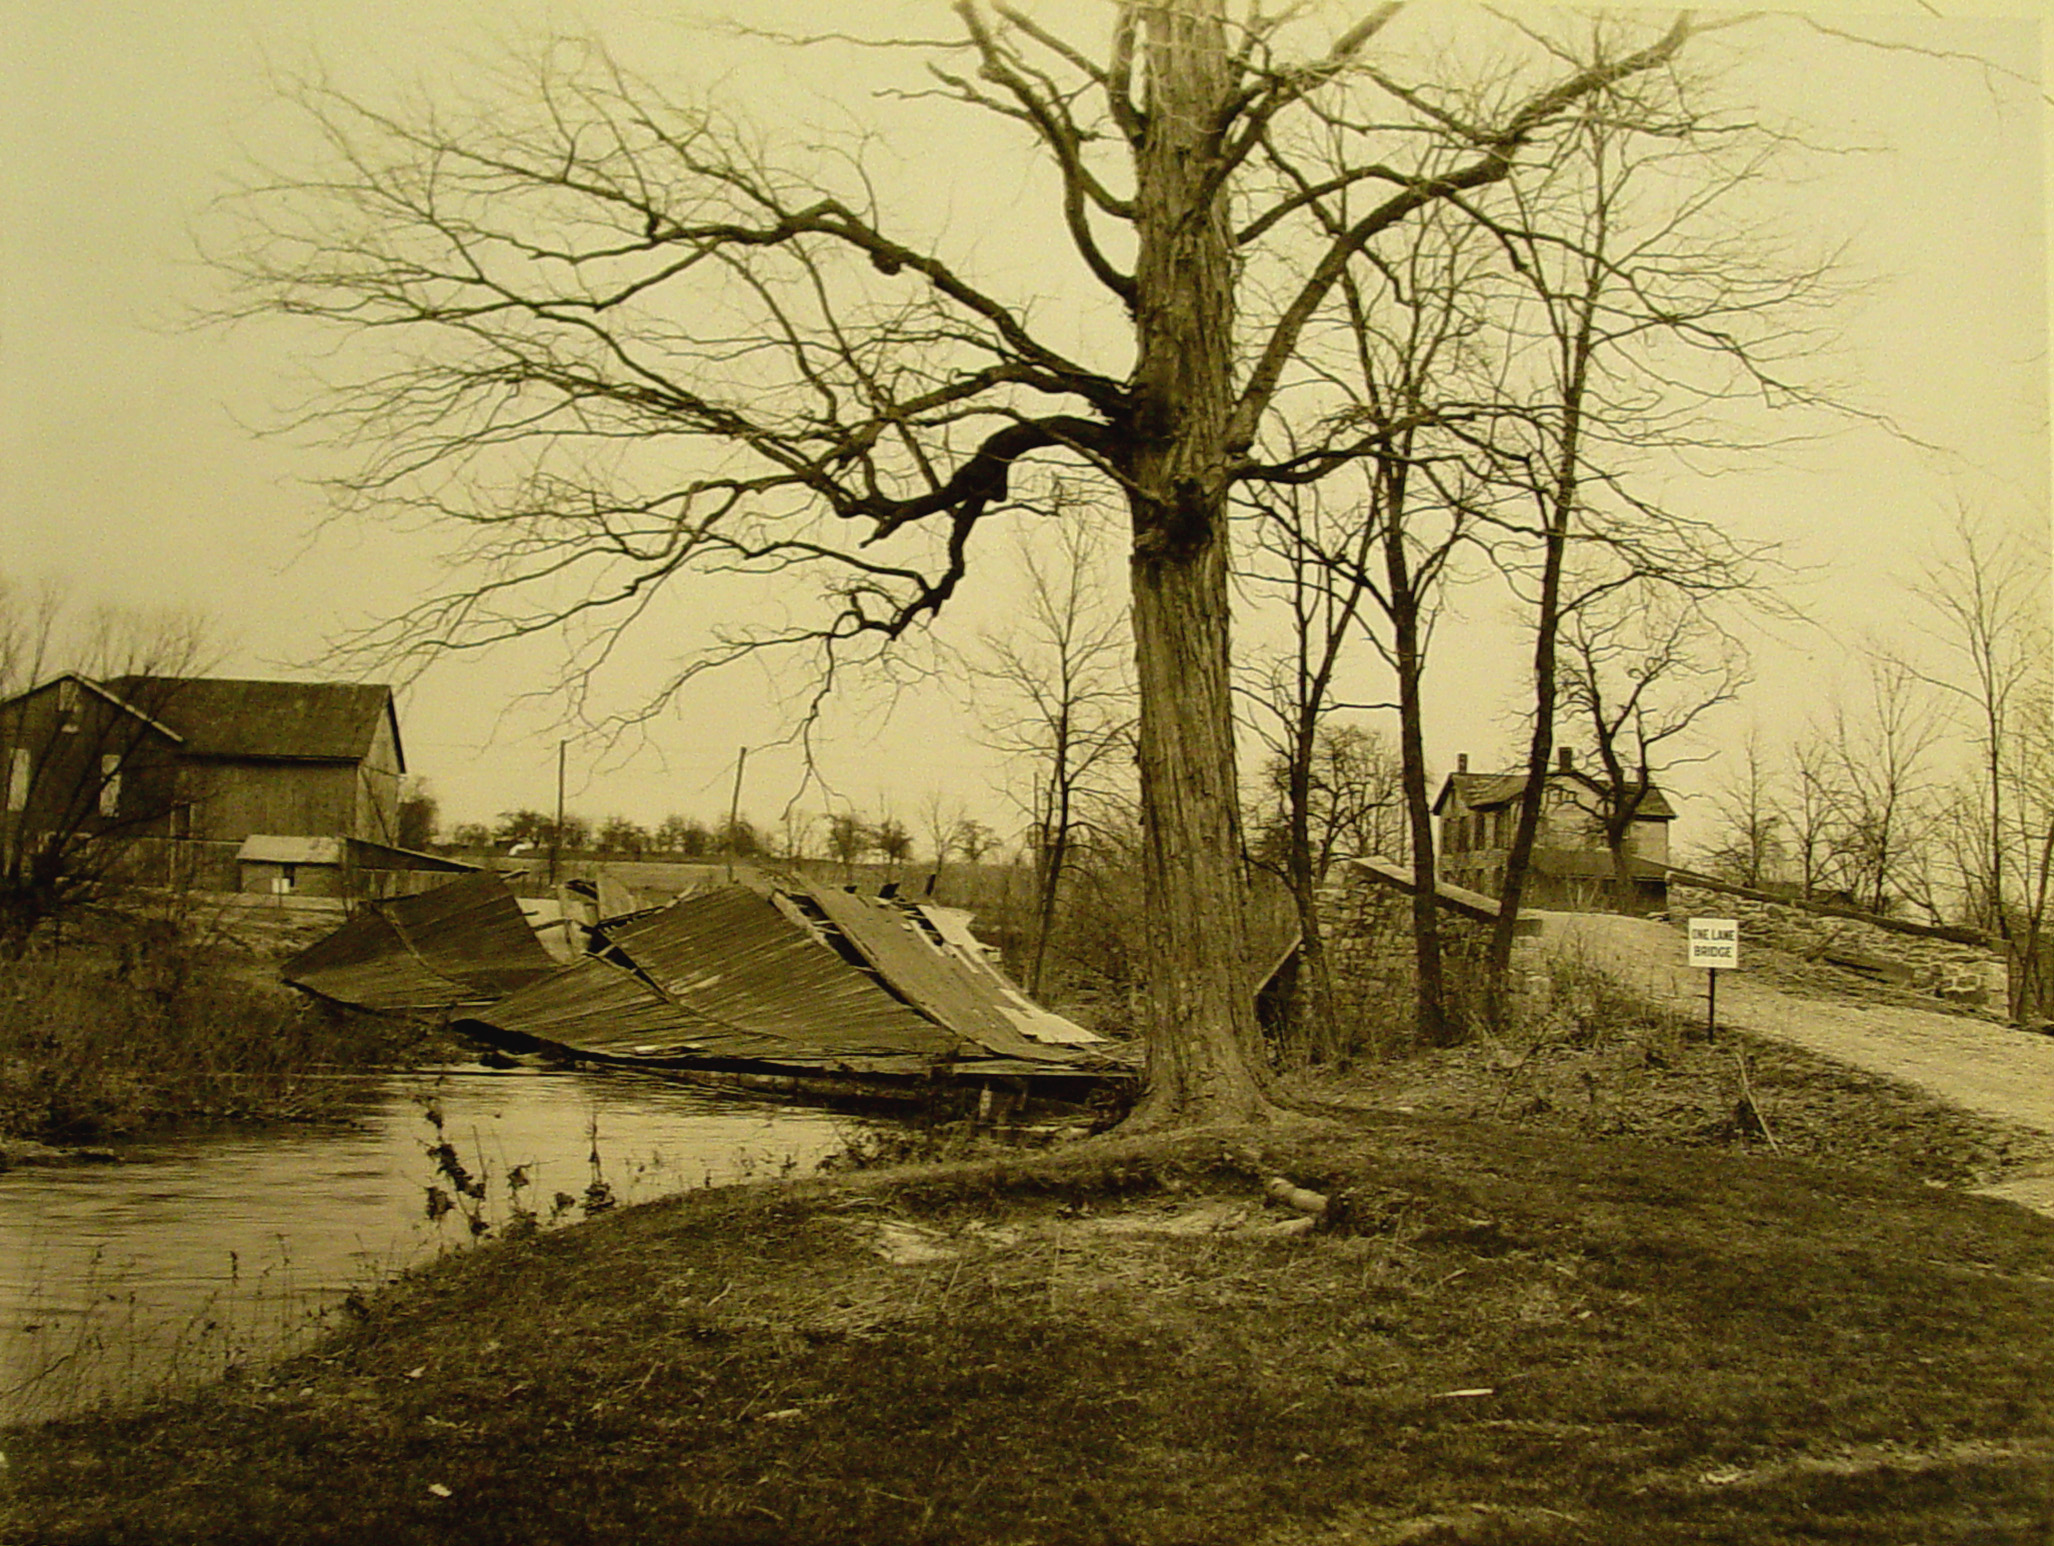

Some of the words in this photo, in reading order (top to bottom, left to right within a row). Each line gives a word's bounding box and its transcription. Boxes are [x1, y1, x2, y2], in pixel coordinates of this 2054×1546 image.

[1692, 928, 1709, 940] ONE
[1711, 929, 1735, 941] LANE
[1694, 945, 1732, 958] BRIDGE
